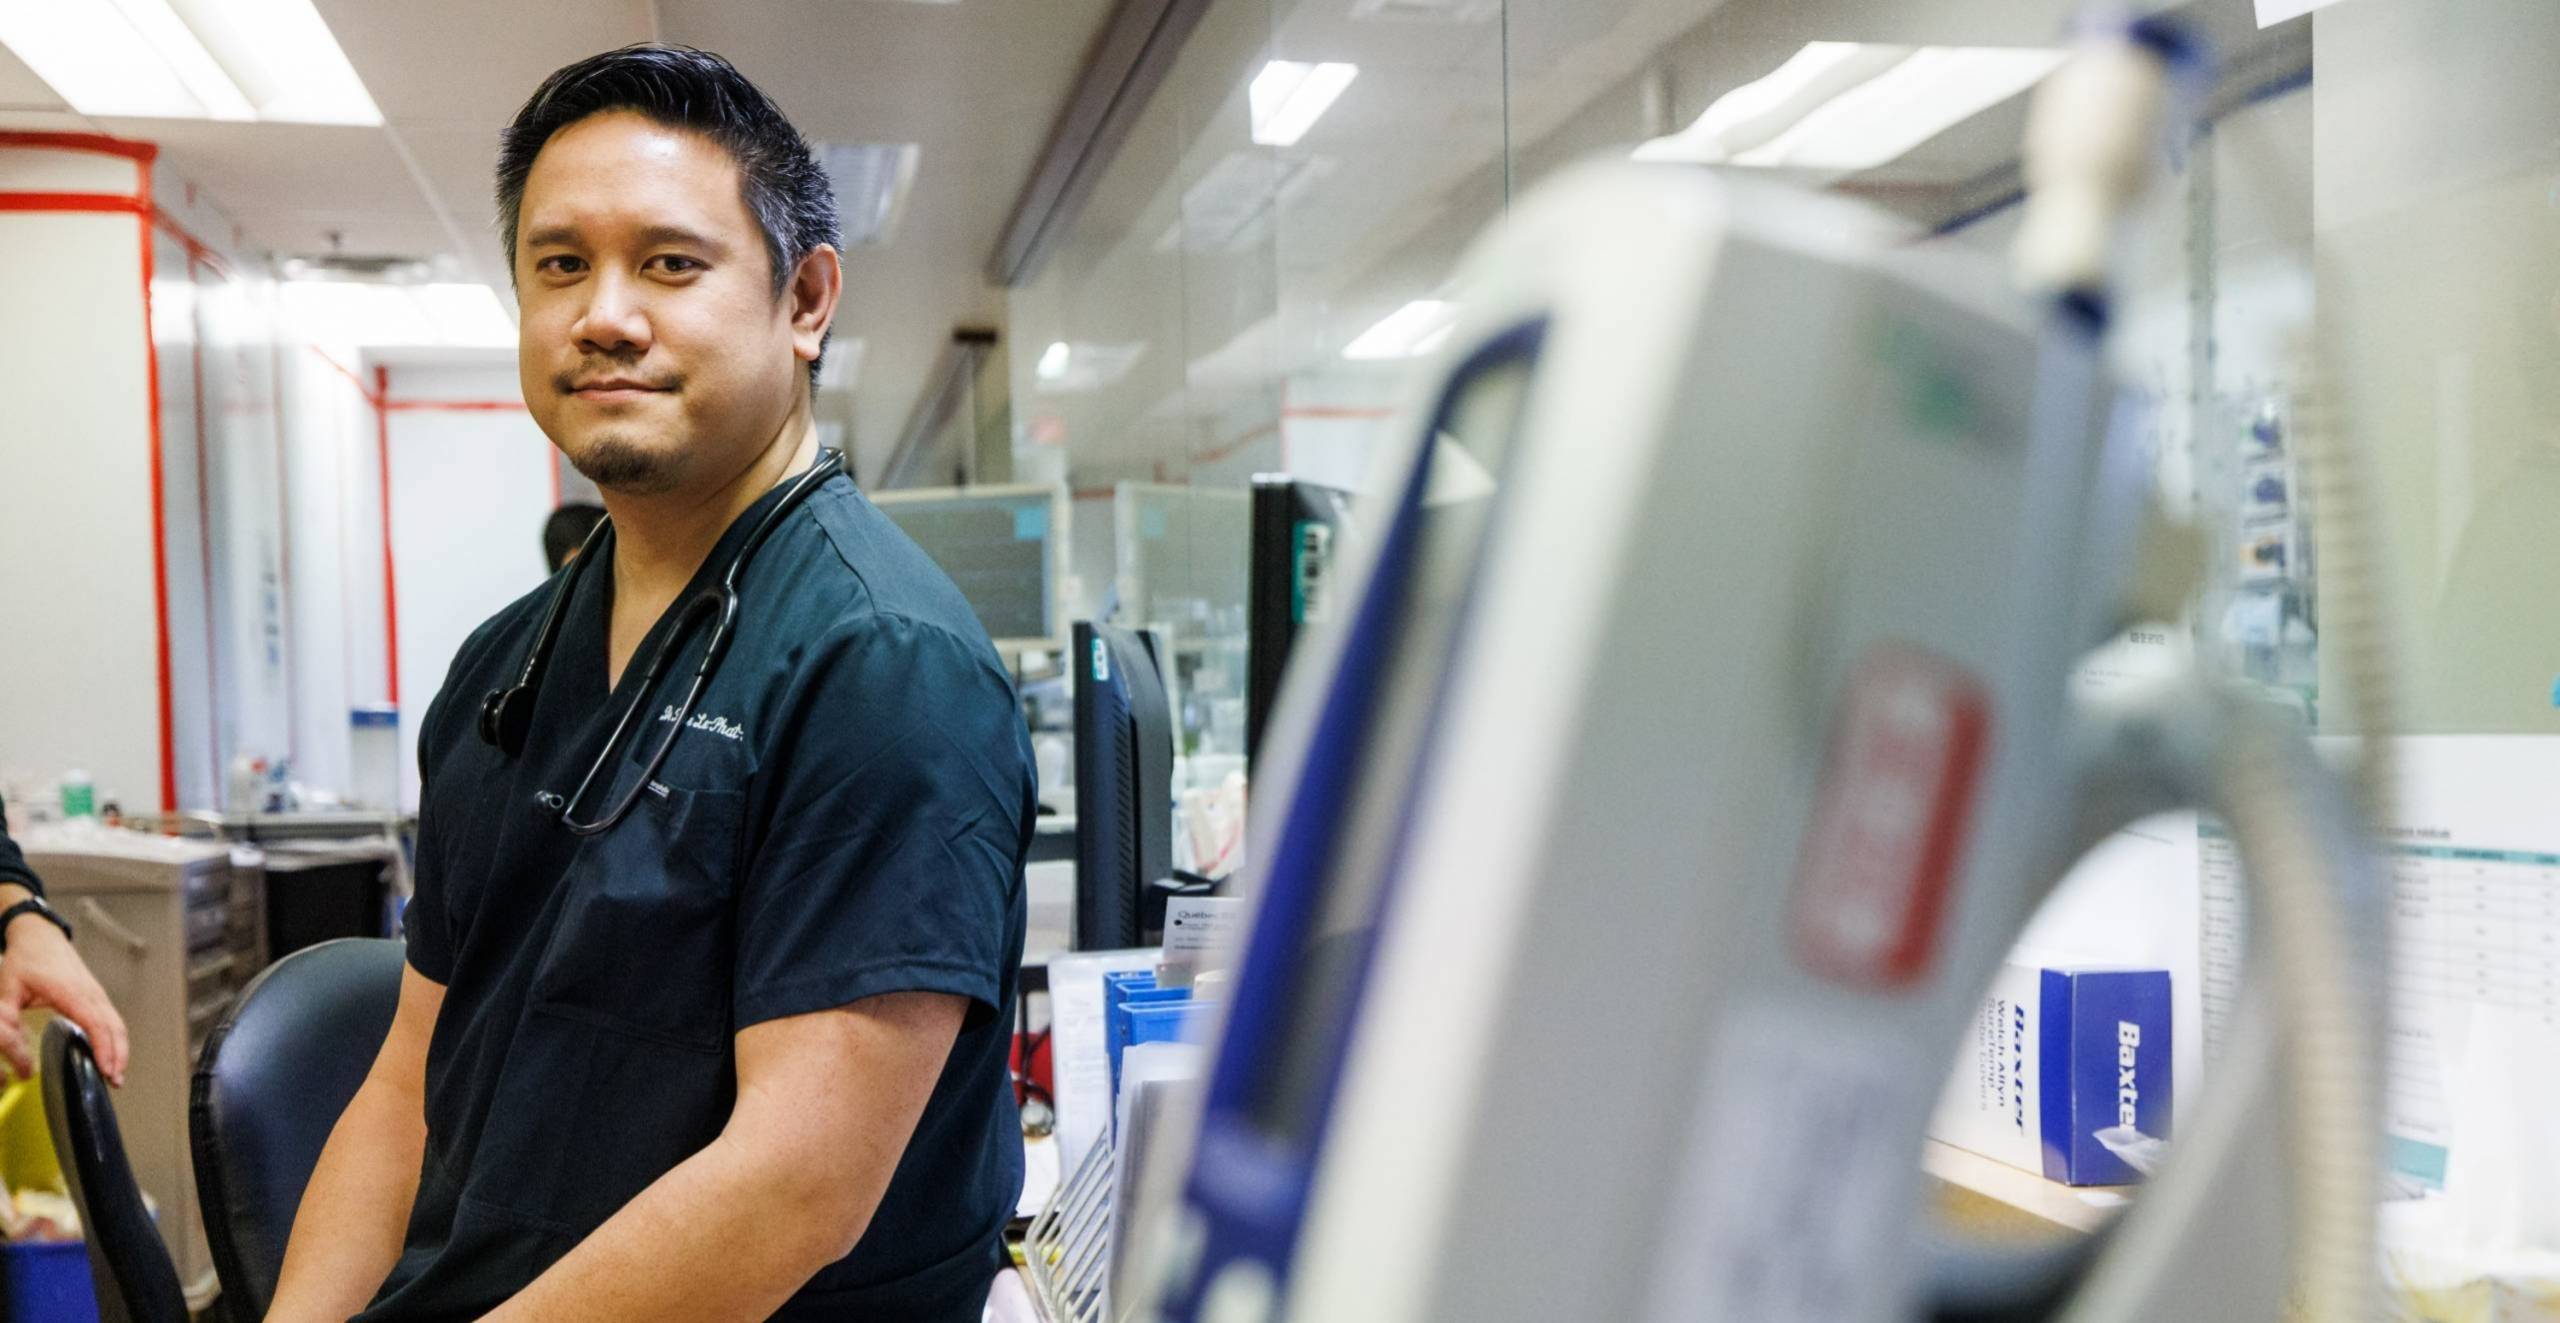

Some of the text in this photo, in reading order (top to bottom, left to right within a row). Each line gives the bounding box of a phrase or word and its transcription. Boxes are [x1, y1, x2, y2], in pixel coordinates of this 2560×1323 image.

[1996, 999, 2006, 1108] Welch Allyn
[2014, 1004, 2025, 1132] Baxter
